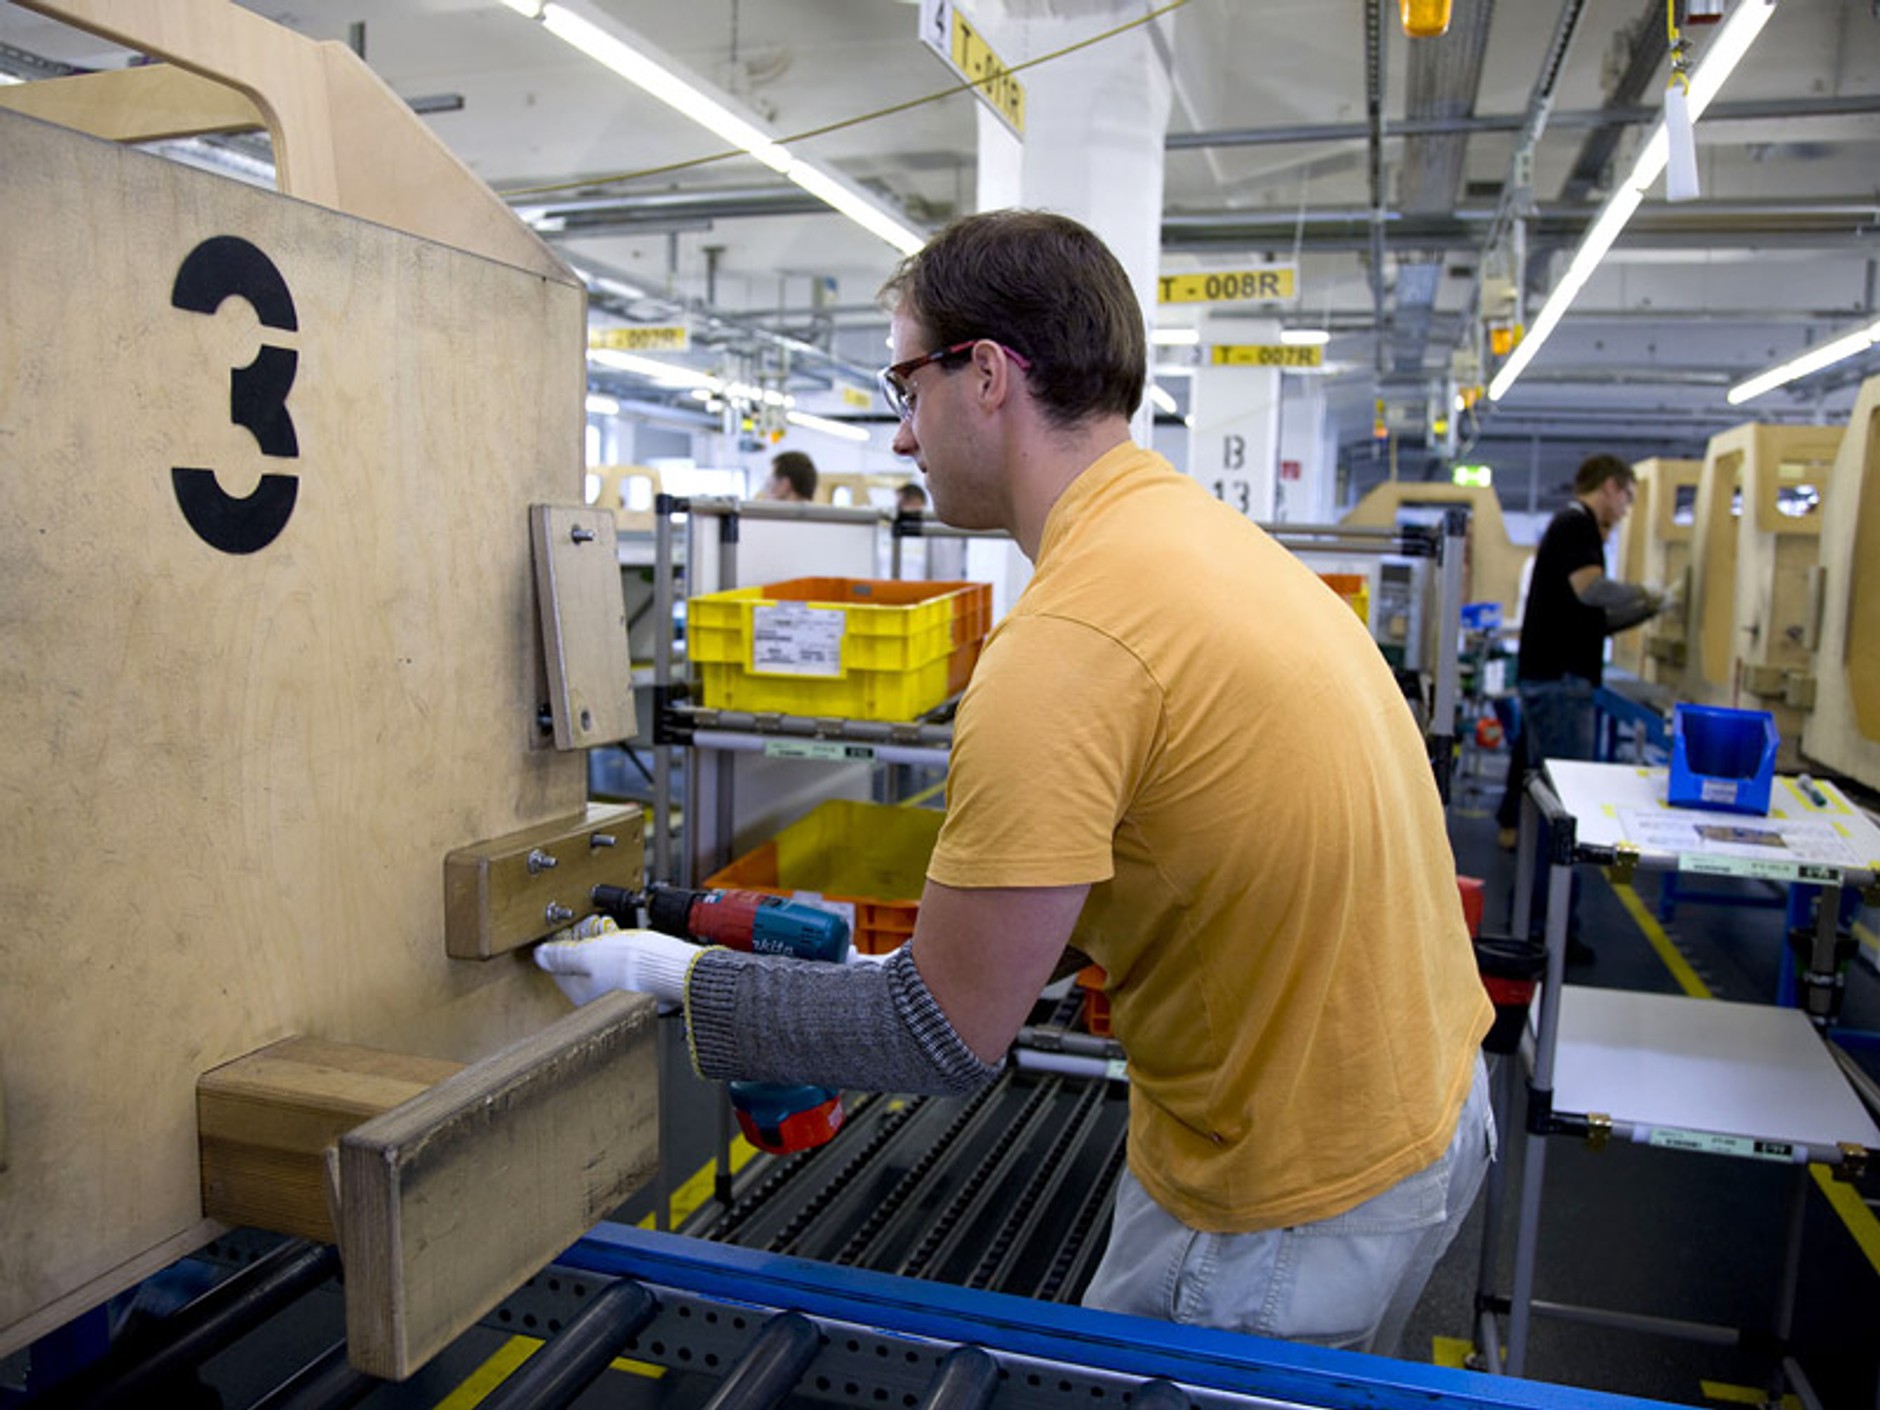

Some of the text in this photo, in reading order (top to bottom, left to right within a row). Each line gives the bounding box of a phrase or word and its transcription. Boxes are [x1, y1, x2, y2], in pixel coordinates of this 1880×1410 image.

[960, 21, 972, 72] T
[1160, 277, 1177, 301] T
[1205, 272, 1280, 300] 008R
[1218, 346, 1233, 364] T
[171, 235, 299, 555] 3
[1223, 434, 1246, 470] B
